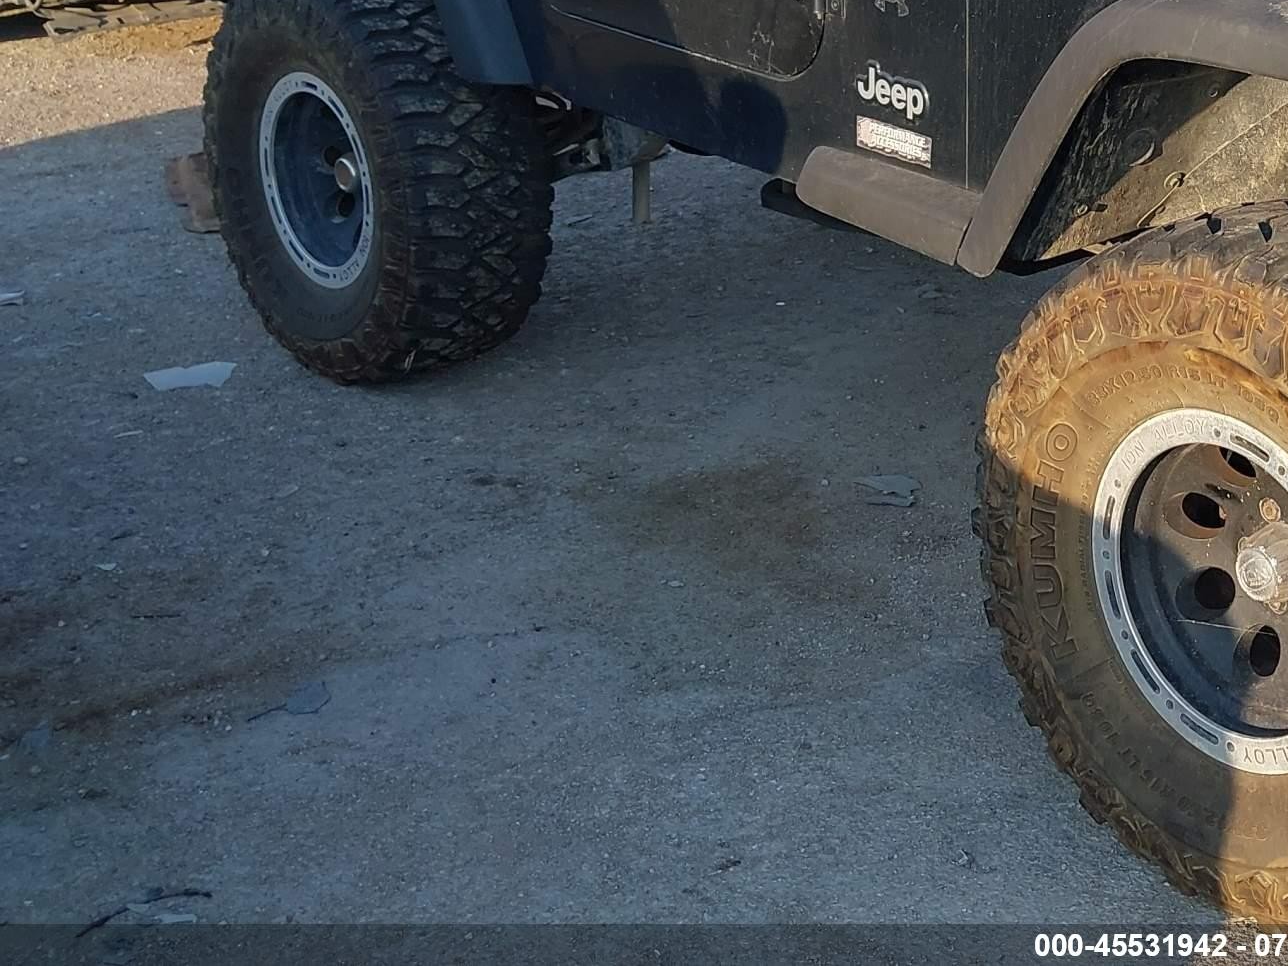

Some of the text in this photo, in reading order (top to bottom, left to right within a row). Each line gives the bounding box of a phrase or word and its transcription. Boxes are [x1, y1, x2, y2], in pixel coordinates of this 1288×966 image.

[857, 66, 924, 120] Jeep
[869, 122, 927, 147] PERFORMANCE
[1121, 417, 1208, 472] ION ALLOY
[1030, 421, 1080, 660] KUMHO
